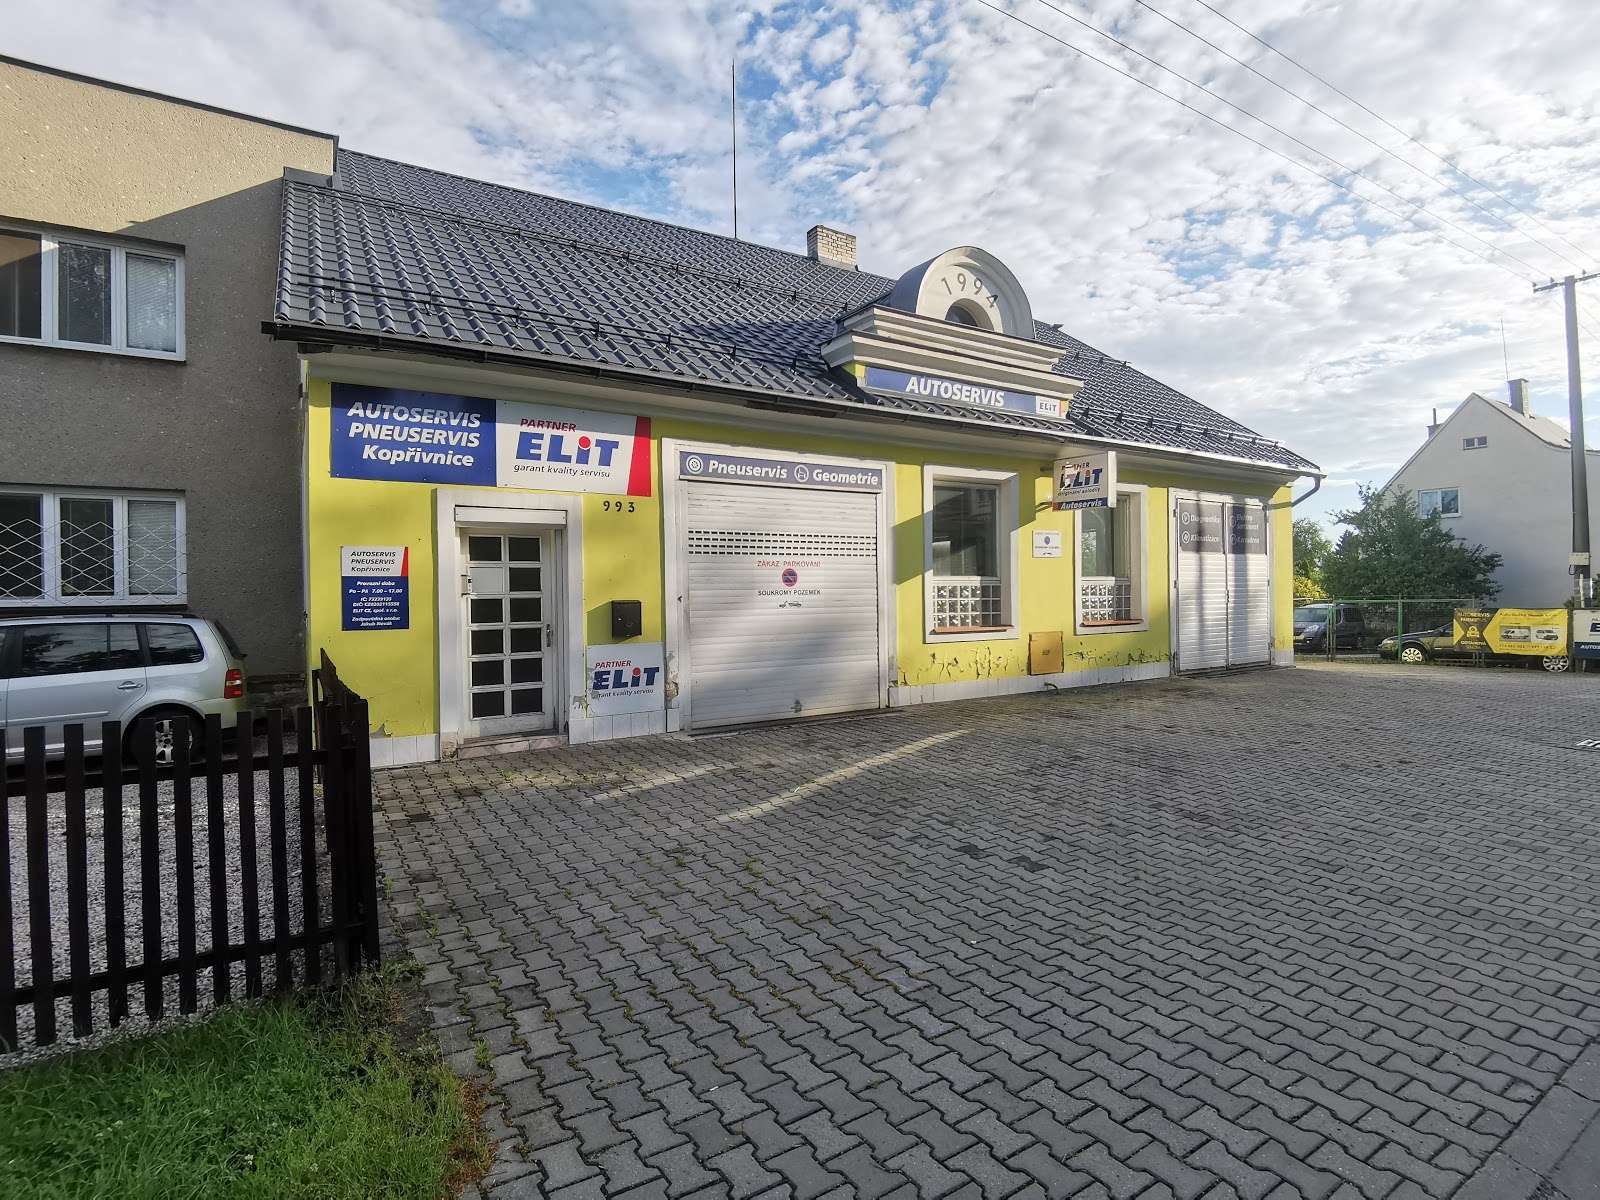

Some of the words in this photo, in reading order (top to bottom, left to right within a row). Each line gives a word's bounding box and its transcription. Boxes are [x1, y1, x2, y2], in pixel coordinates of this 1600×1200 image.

[941, 272, 998, 308] 1994
[905, 376, 1005, 407] AUTOSERVIS
[347, 401, 481, 428] AUTOSERVIS
[520, 418, 577, 432] PARTNER
[348, 421, 480, 448] PNEUSERVIS
[362, 444, 474, 467] Kopřivnice
[513, 463, 545, 474] garant
[547, 464, 578, 477] kvality
[580, 469, 610, 478] servisu
[708, 459, 788, 479] Pneuservis
[812, 469, 879, 485] Geometrie
[603, 500, 635, 513] 993
[1060, 499, 1102, 510] Autoservis
[595, 660, 632, 669] PARTNER
